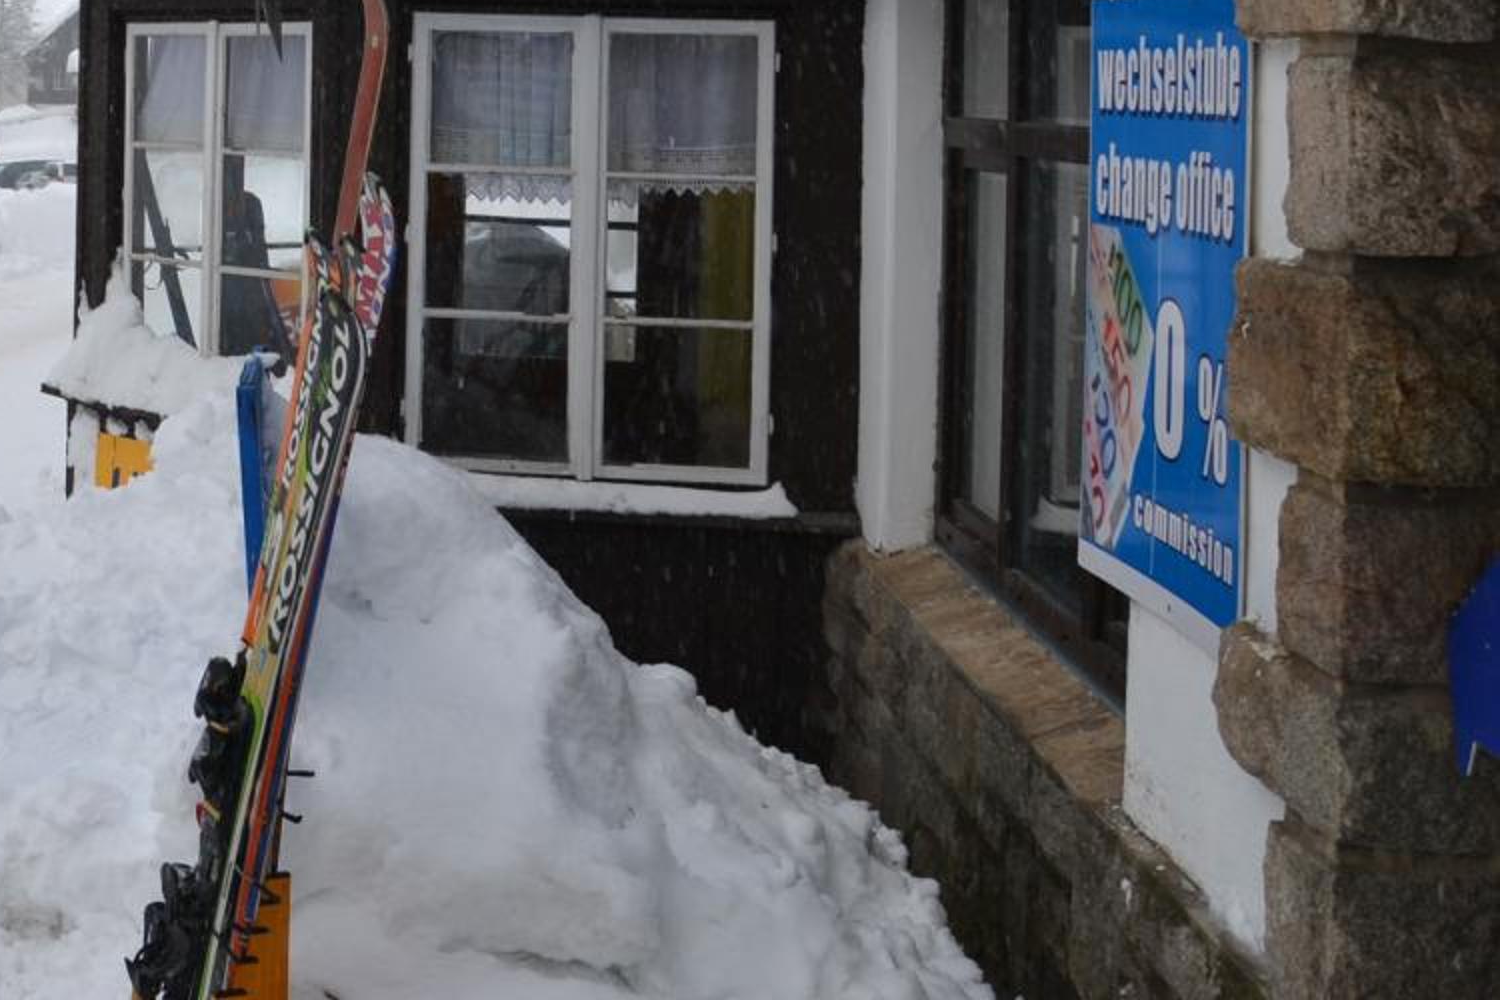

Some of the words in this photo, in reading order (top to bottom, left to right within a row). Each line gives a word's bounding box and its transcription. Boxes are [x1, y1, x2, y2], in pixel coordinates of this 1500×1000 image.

[1097, 31, 1241, 118] wechselstube
[1096, 141, 1172, 235] change
[1175, 150, 1235, 241] office
[1153, 298, 1185, 460] 0
[1197, 354, 1228, 487] %
[267, 320, 351, 642] ROSSIGNOL
[1133, 494, 1233, 586] commission
